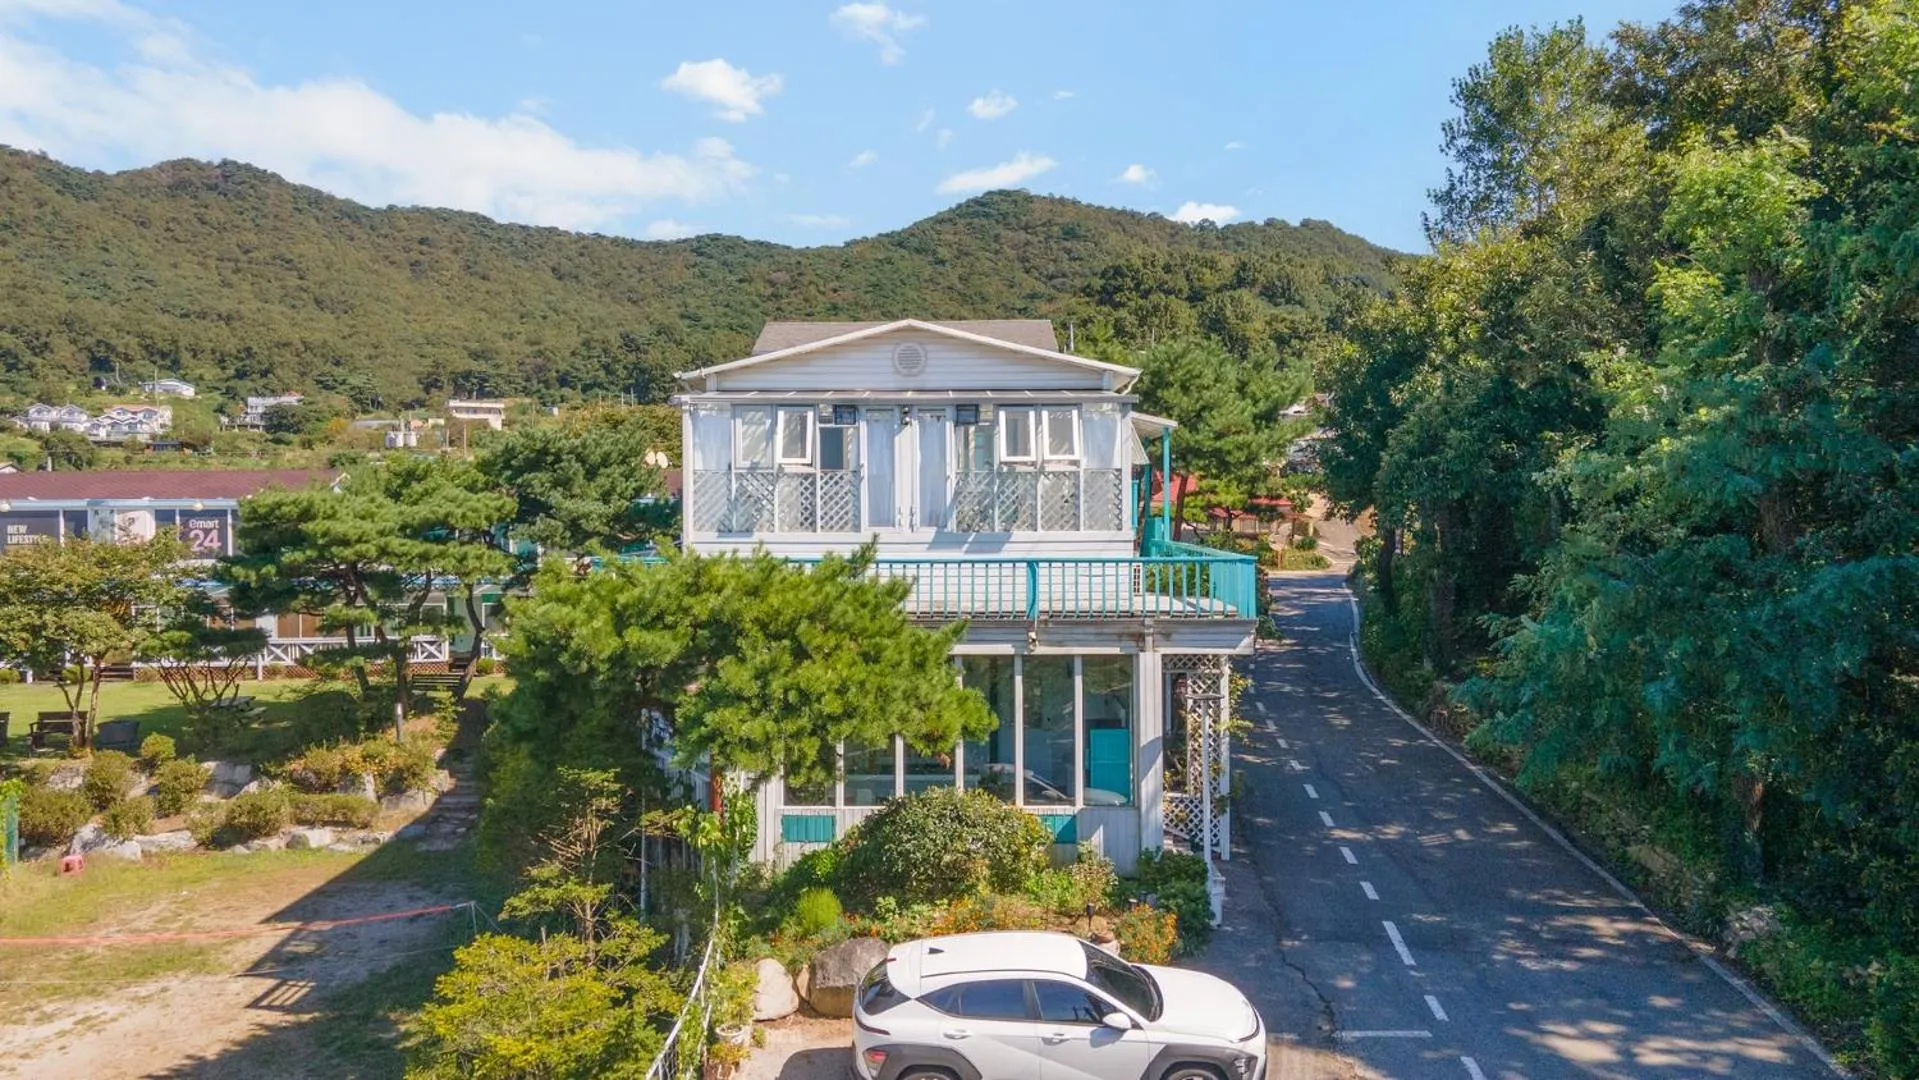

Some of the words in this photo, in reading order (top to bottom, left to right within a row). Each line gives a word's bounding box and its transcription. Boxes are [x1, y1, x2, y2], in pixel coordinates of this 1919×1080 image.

[7, 524, 28, 534] NEW
[189, 519, 220, 529] emart
[190, 529, 222, 552] 24
